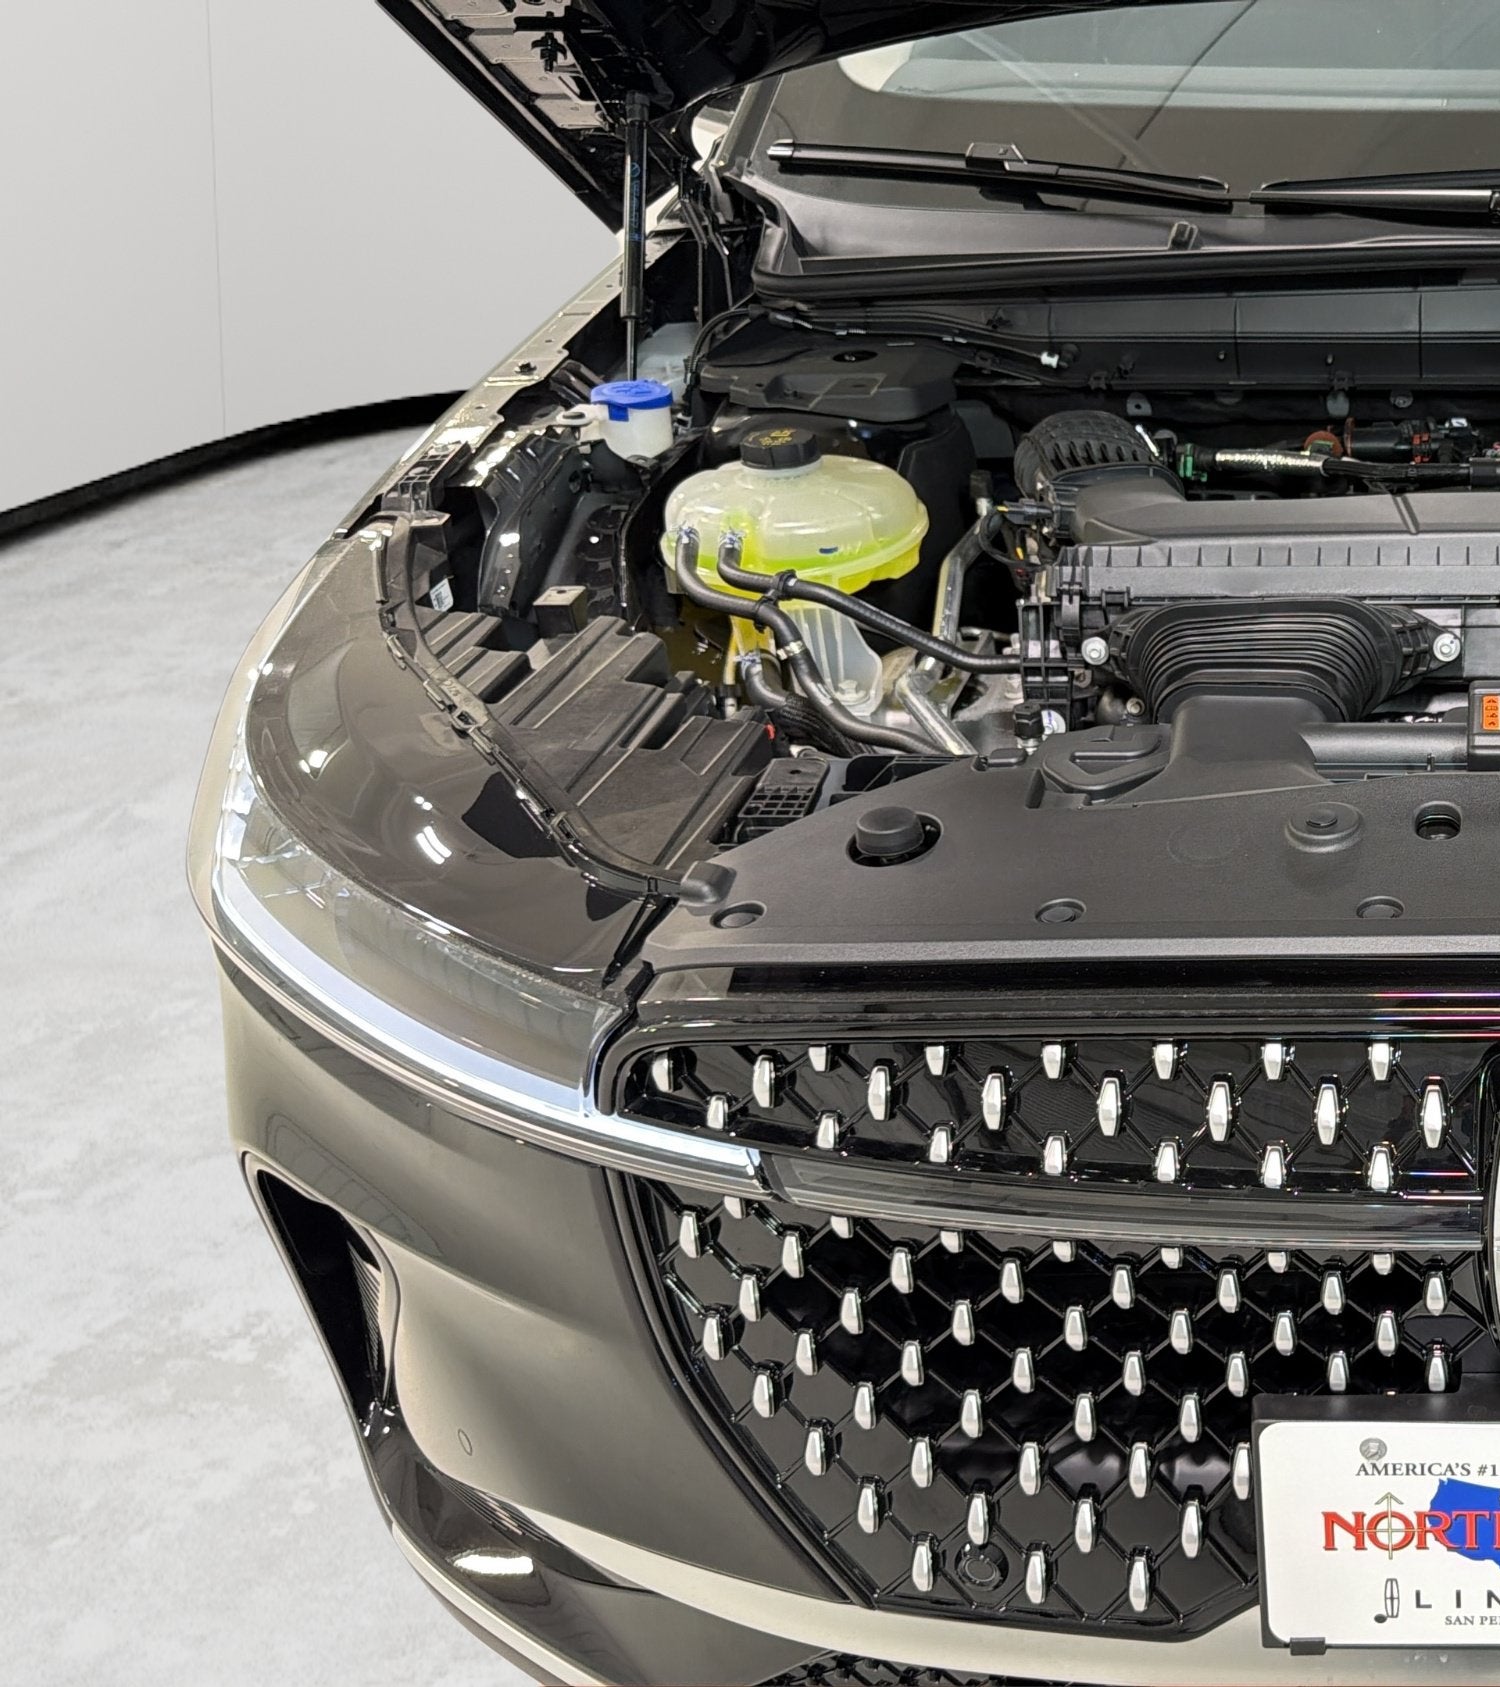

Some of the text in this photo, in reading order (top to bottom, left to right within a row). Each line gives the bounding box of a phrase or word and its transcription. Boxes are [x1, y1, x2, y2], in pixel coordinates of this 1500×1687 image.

[1355, 1462, 1472, 1478] AMERICA'S
[1477, 1463, 1499, 1477] #1
[1444, 1614, 1476, 1626] SAN
